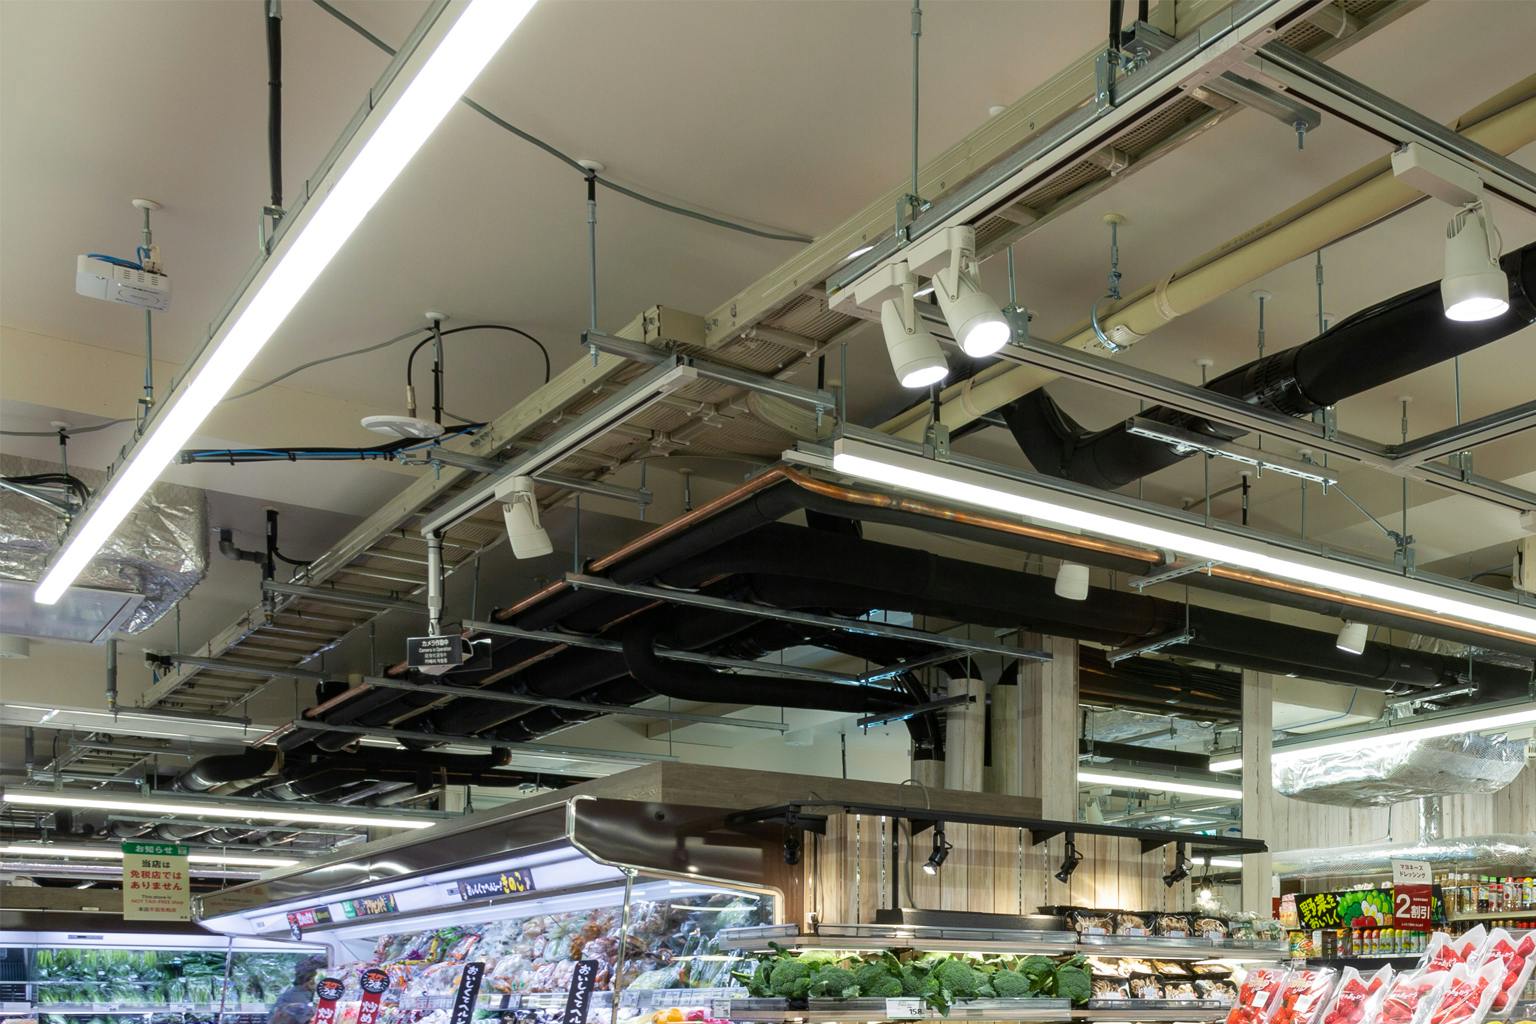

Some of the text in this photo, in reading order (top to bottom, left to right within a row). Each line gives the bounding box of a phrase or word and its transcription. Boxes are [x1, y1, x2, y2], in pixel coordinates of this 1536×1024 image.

[135, 845, 173, 854] お知らせ
[142, 860, 170, 868] 当店は
[130, 870, 182, 880] 免税店では
[130, 881, 182, 891] ありません
[1300, 893, 1337, 923] 野菜を
[1396, 893, 1430, 919] 2割引
[1310, 911, 1340, 929] おいしく
